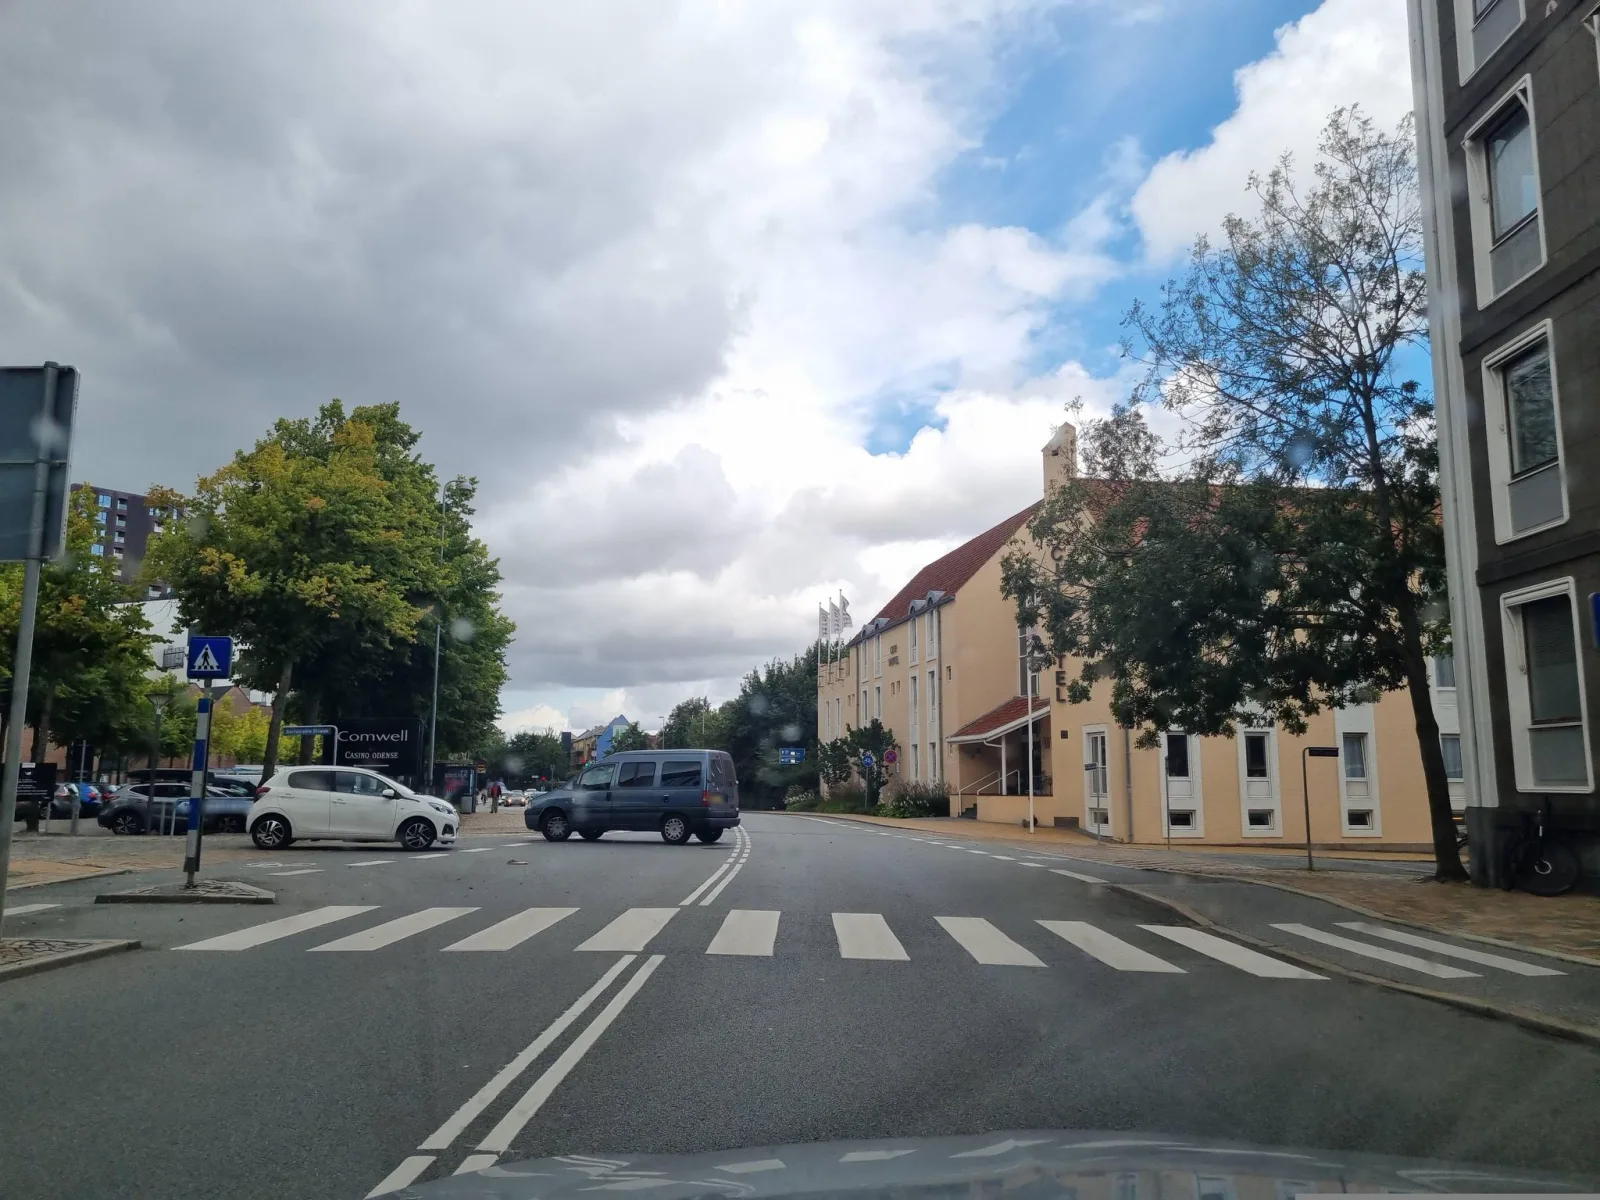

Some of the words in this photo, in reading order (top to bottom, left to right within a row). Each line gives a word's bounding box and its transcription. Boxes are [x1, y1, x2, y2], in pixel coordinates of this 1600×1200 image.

[337, 729, 408, 742] Comwell
[344, 751, 370, 759] CASINO
[372, 751, 399, 759] ODENSE
